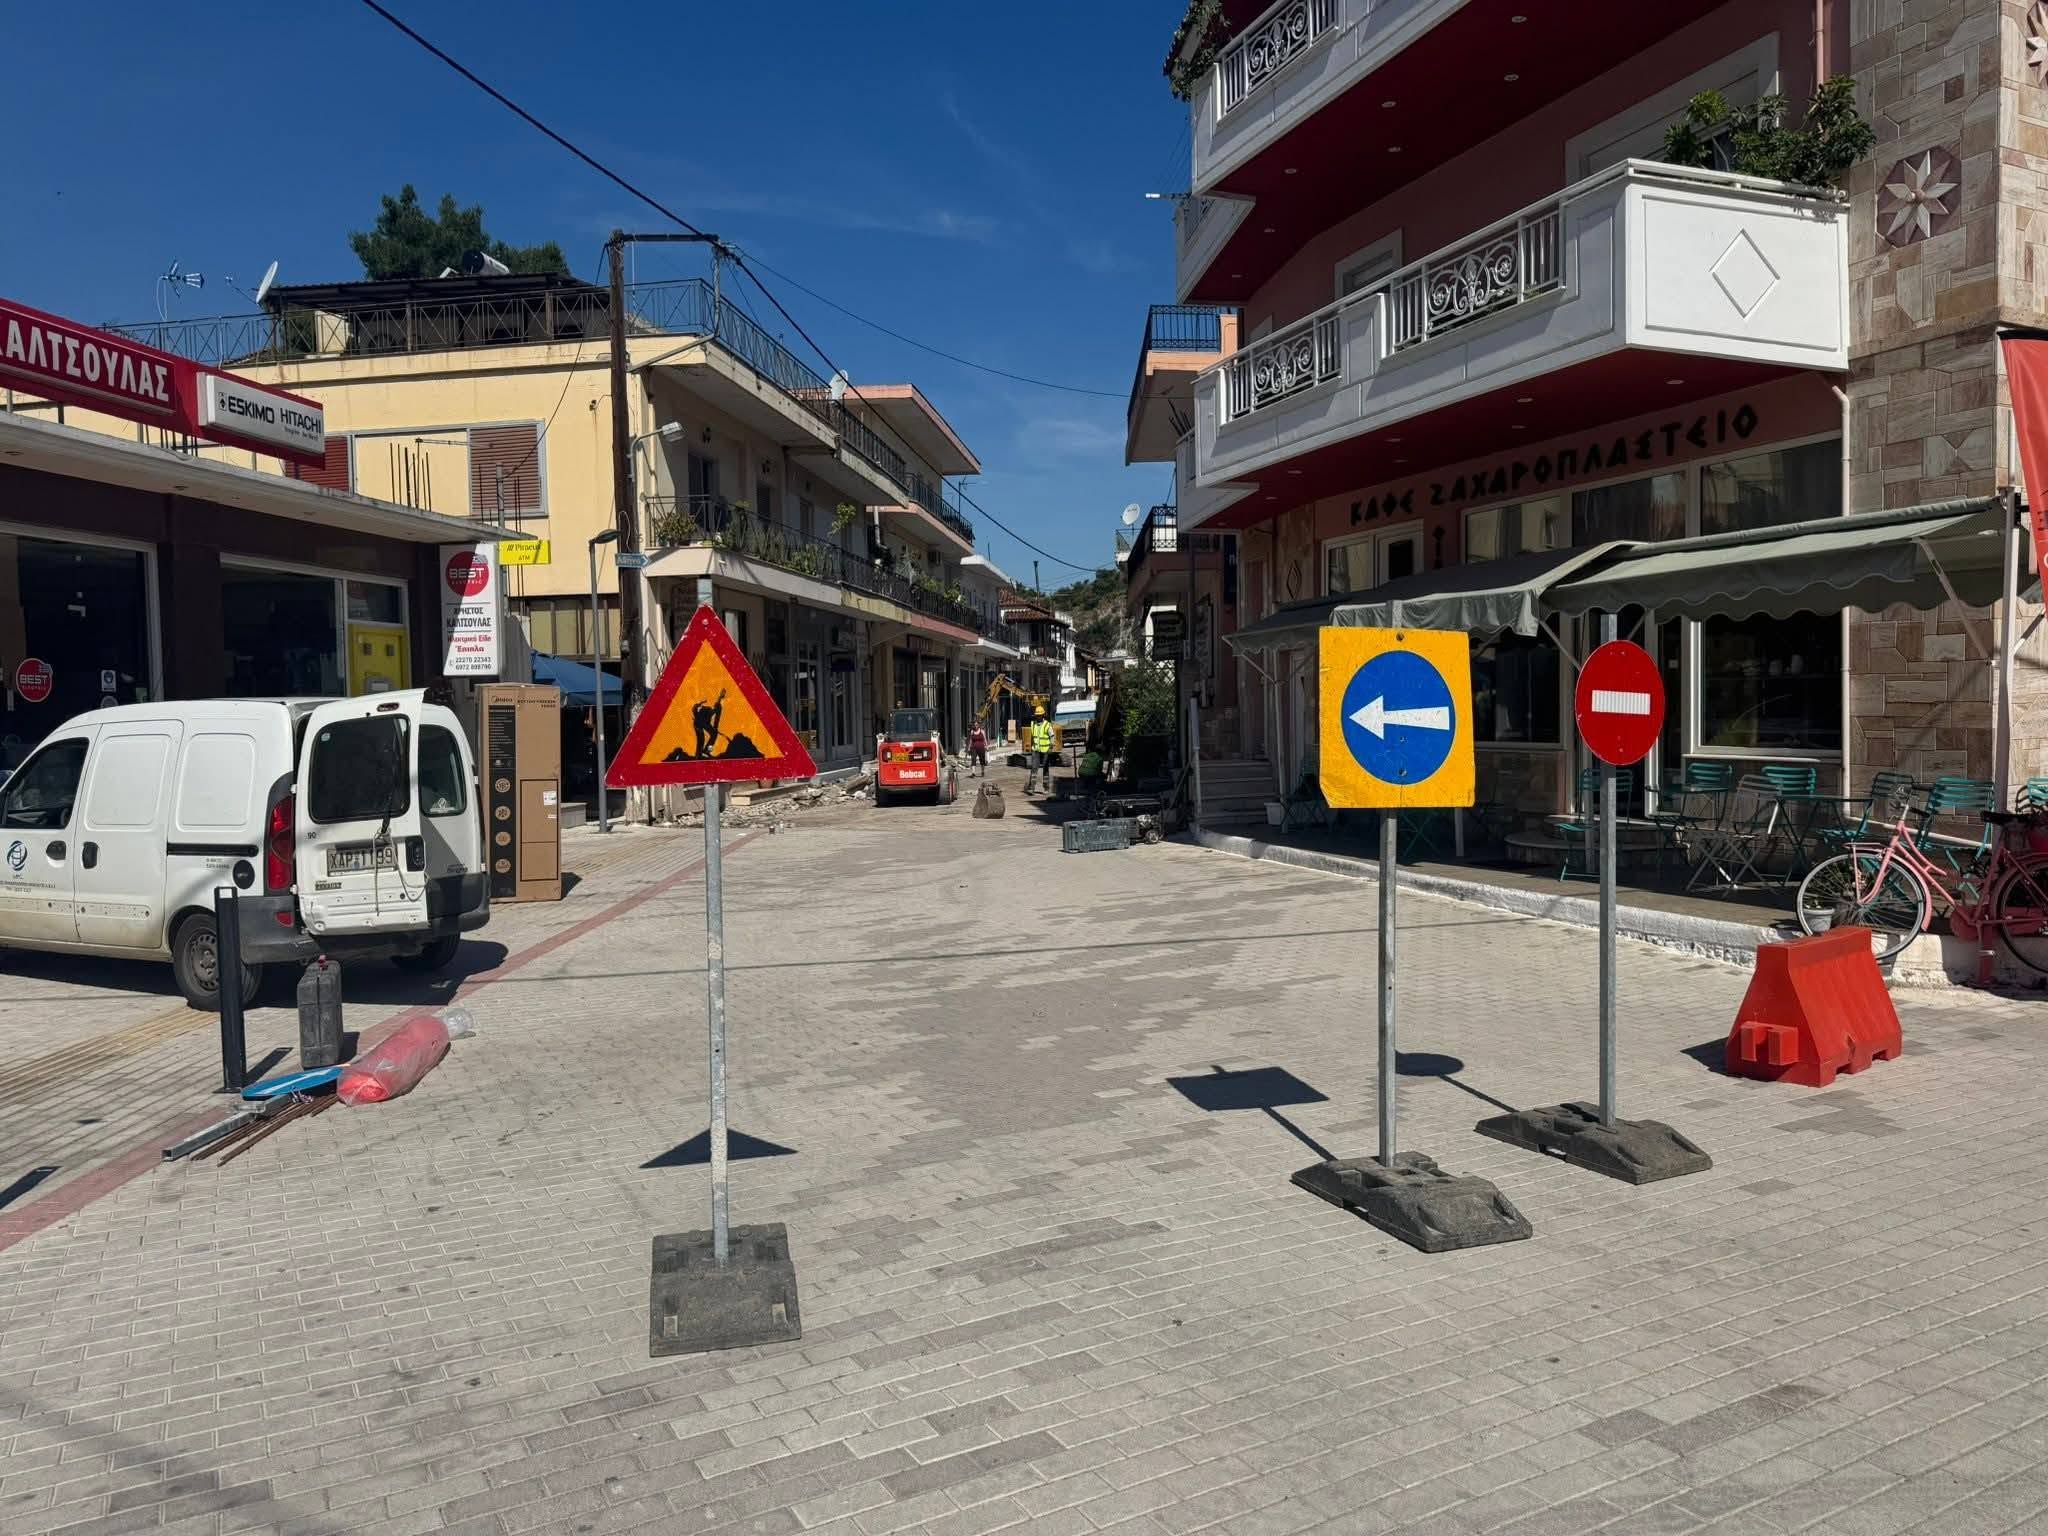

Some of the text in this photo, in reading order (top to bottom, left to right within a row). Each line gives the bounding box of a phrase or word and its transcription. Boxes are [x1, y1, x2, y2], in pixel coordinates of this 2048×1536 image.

[0, 319, 169, 402] ΑΛΤΣΟΥΛΑΣ
[228, 396, 275, 424] ESKIMO
[280, 408, 322, 433] HITACHI
[1430, 403, 1758, 506] ΖΑΧΑΡΟΠΛΑΣΤΕΙΟ
[449, 567, 485, 579] BEST
[453, 607, 484, 615] ΧΡΗΣΤΟΣ
[447, 617, 492, 627] ΚΑΛΤΣΟΥΛΑΣ
[20, 674, 48, 684] BEST
[899, 769, 926, 779] Bobcat
